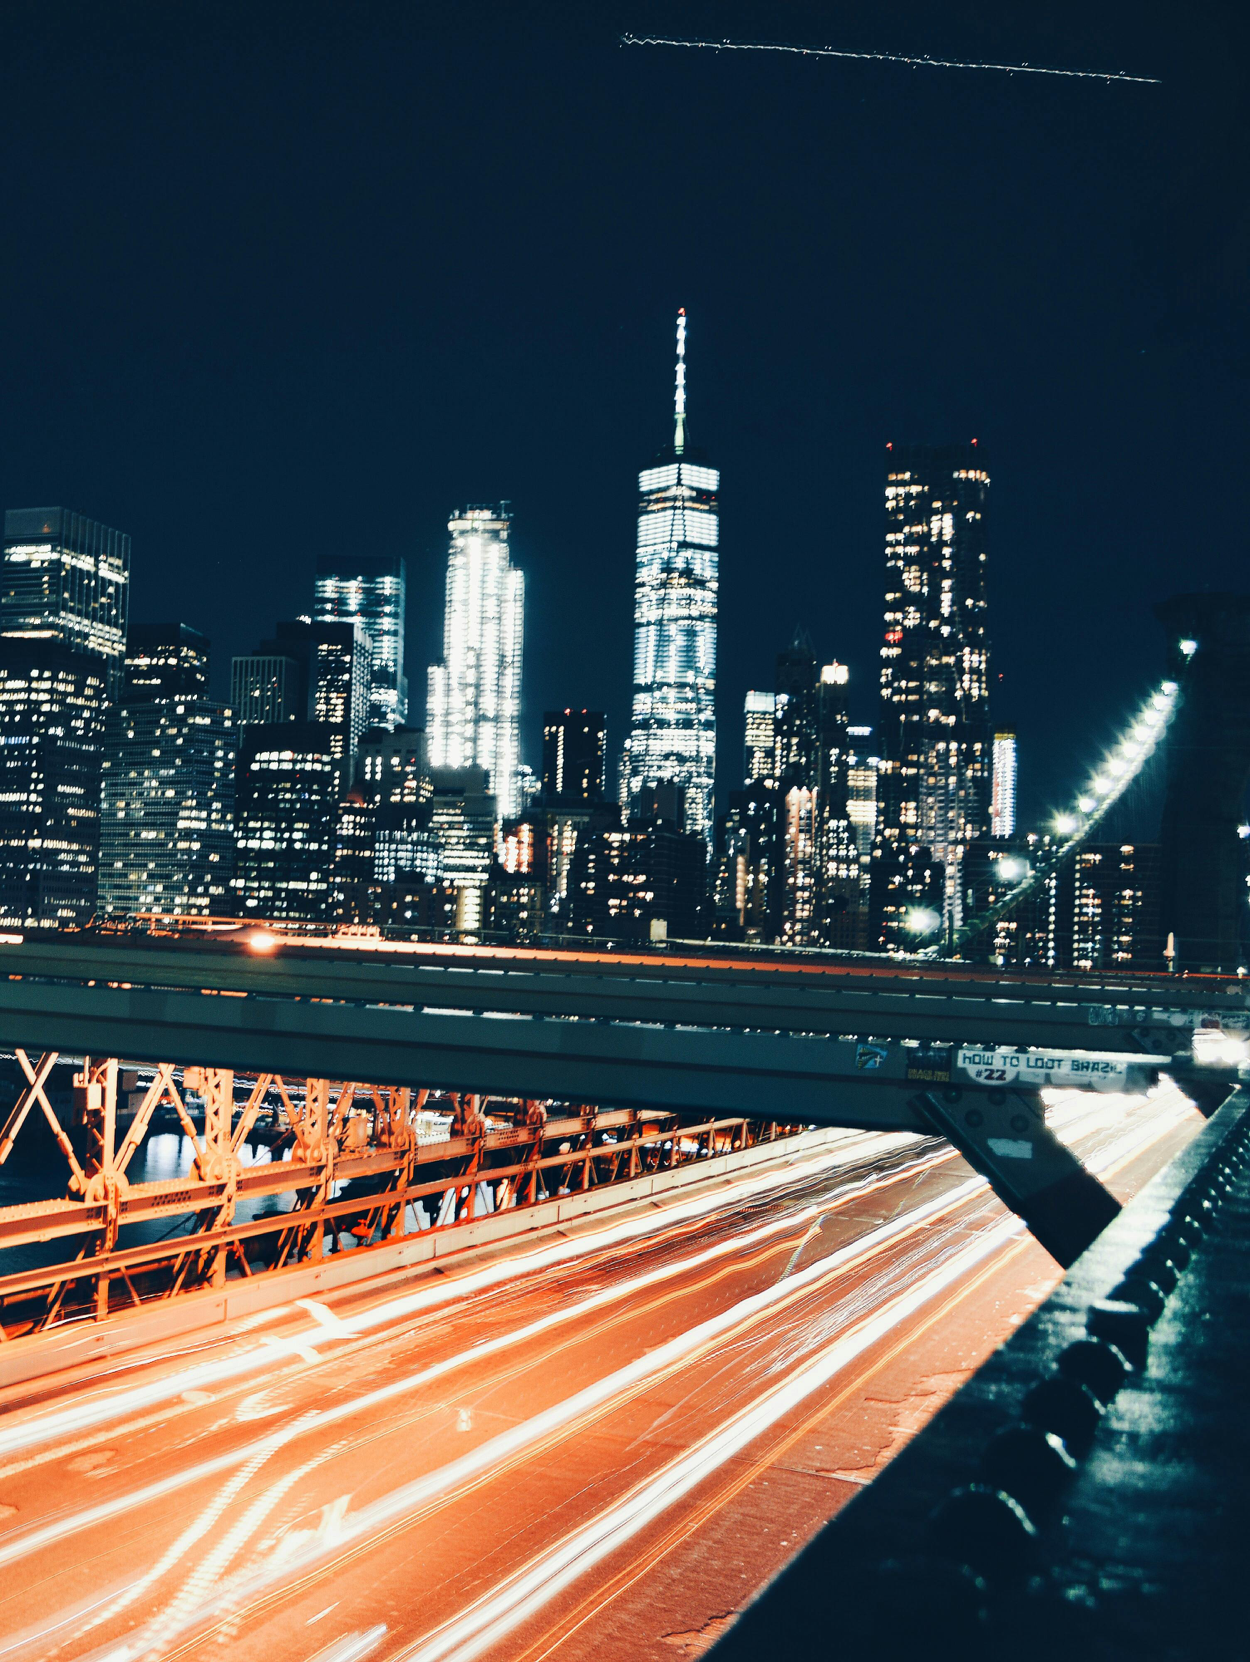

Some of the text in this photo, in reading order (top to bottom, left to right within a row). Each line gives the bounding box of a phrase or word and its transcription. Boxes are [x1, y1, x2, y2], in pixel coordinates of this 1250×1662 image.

[1001, 1055, 1019, 1067] TO
[1026, 1057, 1064, 1069] LOOT
[975, 1068, 1007, 1081] #22
